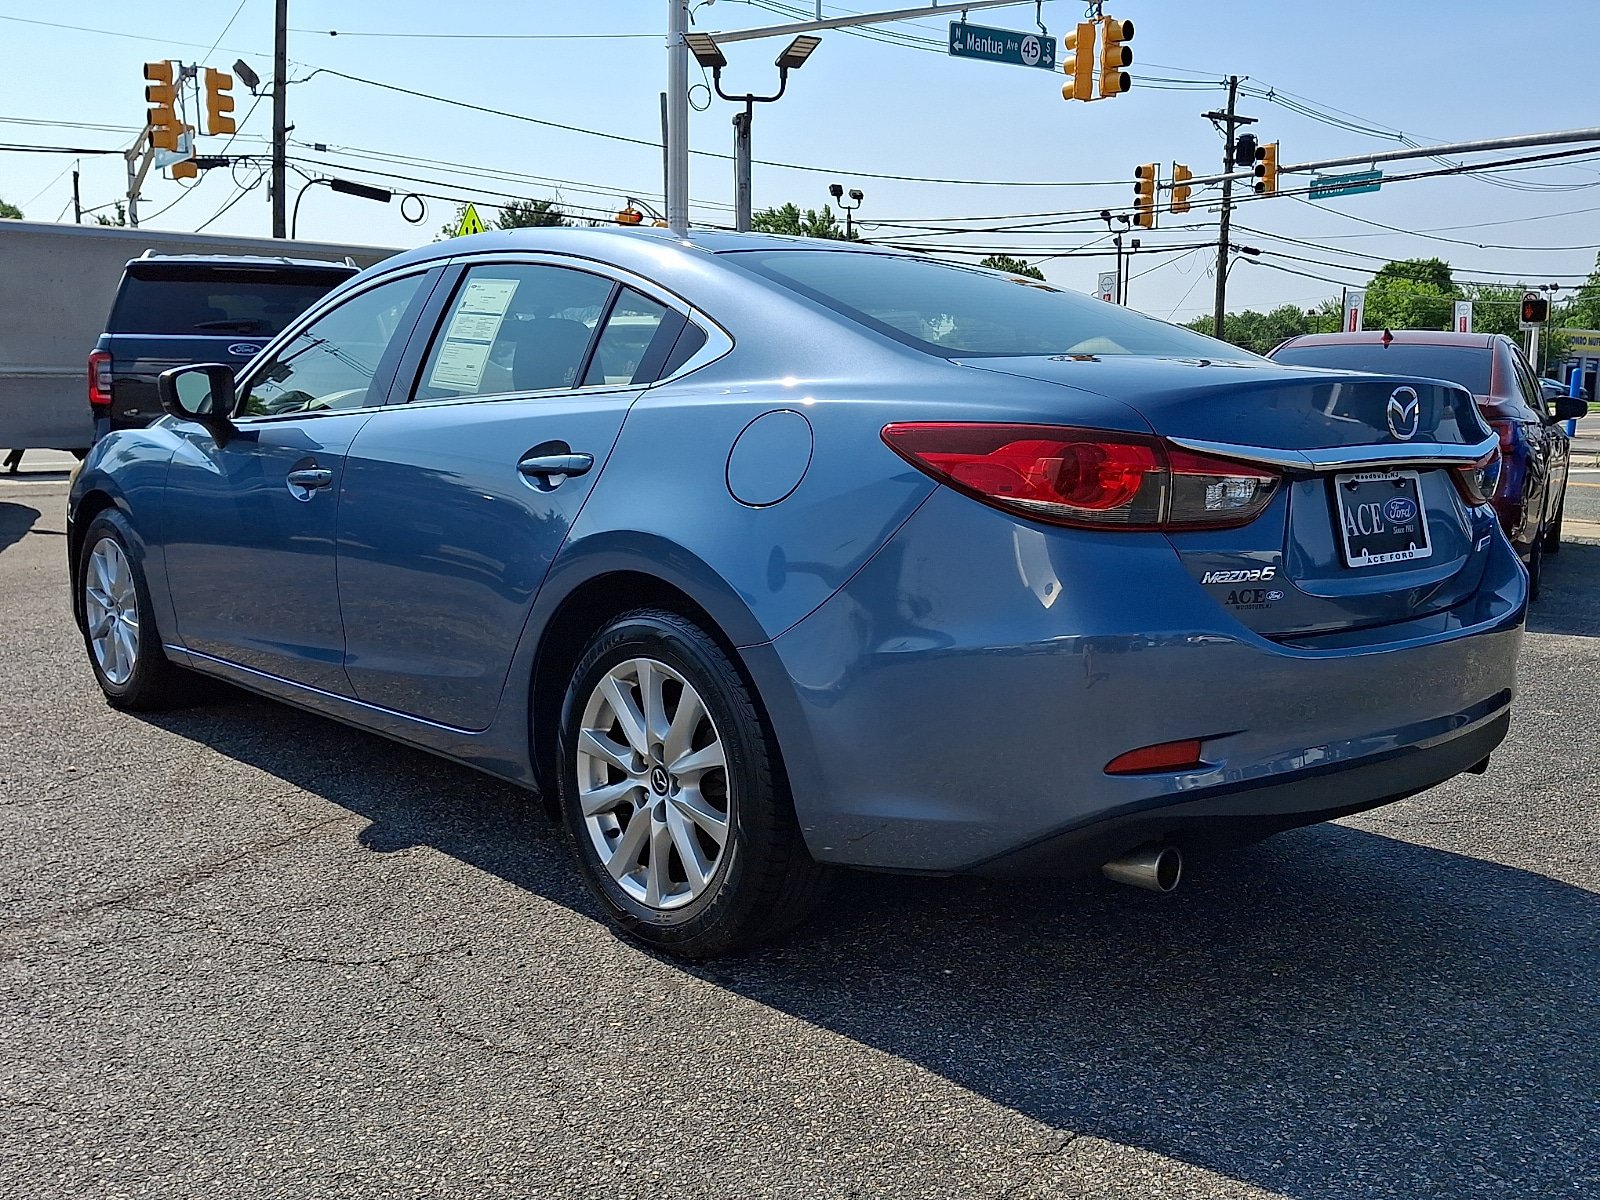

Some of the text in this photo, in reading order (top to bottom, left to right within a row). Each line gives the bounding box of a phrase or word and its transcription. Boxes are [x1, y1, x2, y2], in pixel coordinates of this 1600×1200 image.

[955, 27, 962, 39] N
[966, 32, 1019, 55] Mantua Ave
[1022, 40, 1039, 58] 45
[1045, 41, 1051, 53] S
[1346, 501, 1412, 537] ACE Ford
[1390, 551, 1414, 560] FORD
[1224, 588, 1266, 605] ACE
